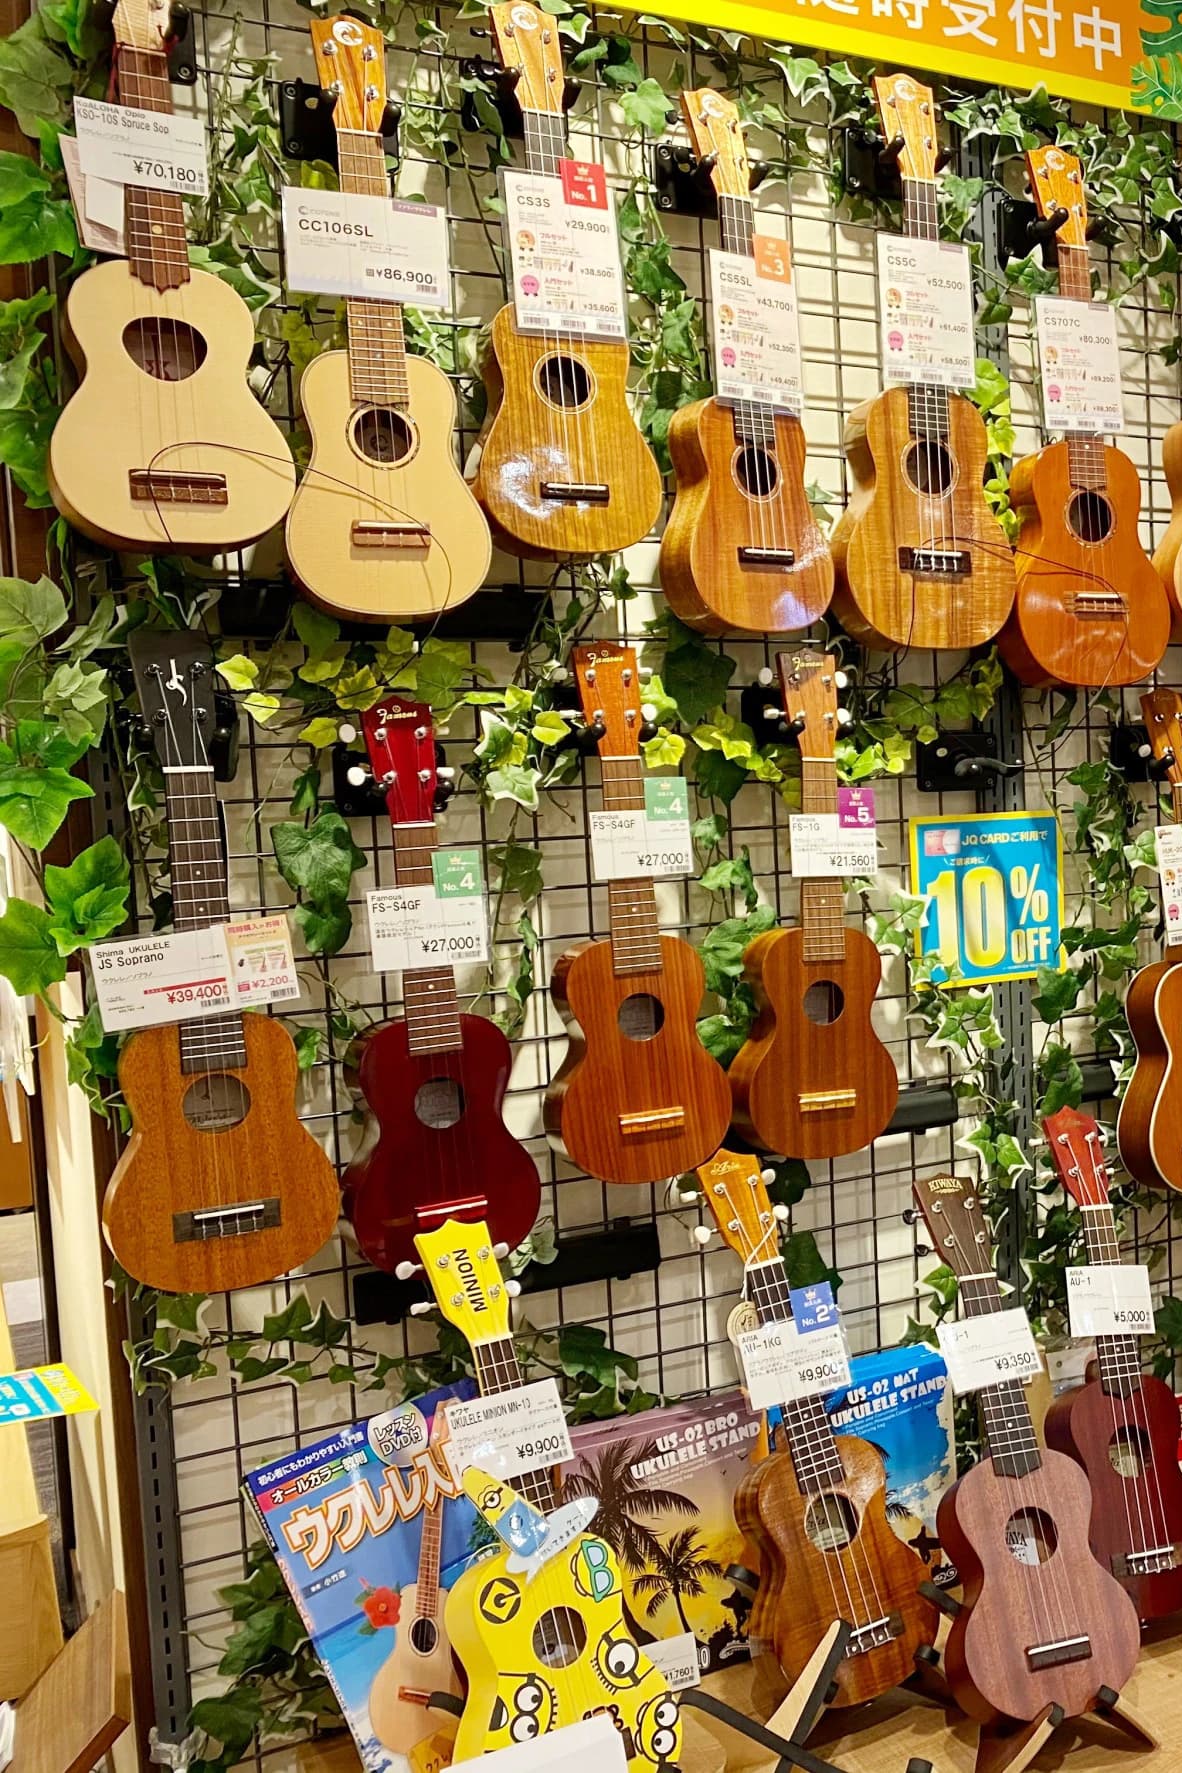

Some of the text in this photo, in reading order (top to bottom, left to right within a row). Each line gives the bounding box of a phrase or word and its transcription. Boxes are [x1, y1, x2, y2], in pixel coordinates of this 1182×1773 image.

[121, 116, 151, 132] Spruce
[133, 160, 196, 184] ¥70,180
[517, 195, 551, 208] CS3S
[298, 218, 374, 238] CC106SL
[565, 220, 606, 233] ¥29,900
[887, 255, 917, 268] CS5C
[376, 268, 433, 285] ¥86,900
[719, 271, 753, 287] CS5SL
[1044, 316, 1081, 328] CS707C
[592, 819, 636, 830] FS-S4GF
[791, 821, 820, 832] FS-1G
[637, 852, 684, 867] ¥27,000
[829, 855, 870, 867] ¥21,560
[442, 872, 476, 891] No.4
[371, 900, 421, 913] FS-S4GF
[96, 940, 171, 959] Shima UKULELE
[420, 936, 474, 953] ¥27,000
[1010, 925, 1051, 964] OFF
[98, 951, 165, 970] JS Soprano
[252, 974, 289, 989] ¥2,200
[166, 984, 223, 1005] ¥39,400
[927, 1177, 963, 1194] KIWAYA
[452, 1247, 489, 1313] MINION
[1070, 1276, 1091, 1287] AU-1
[801, 1304, 831, 1327] No.2
[1113, 1310, 1146, 1323] ¥5,000
[994, 1352, 1034, 1372] ¥9,350
[847, 1376, 891, 1404] US-02
[829, 1389, 899, 1428] UKULELE
[899, 1375, 947, 1405] STAND
[373, 1412, 416, 1439] レッスン
[656, 1411, 739, 1453] US-02 BRO
[381, 1429, 423, 1457] DVD付
[515, 1435, 560, 1460] ¥9,900
[630, 1441, 708, 1480] UKULELE
[709, 1422, 761, 1448] STAND
